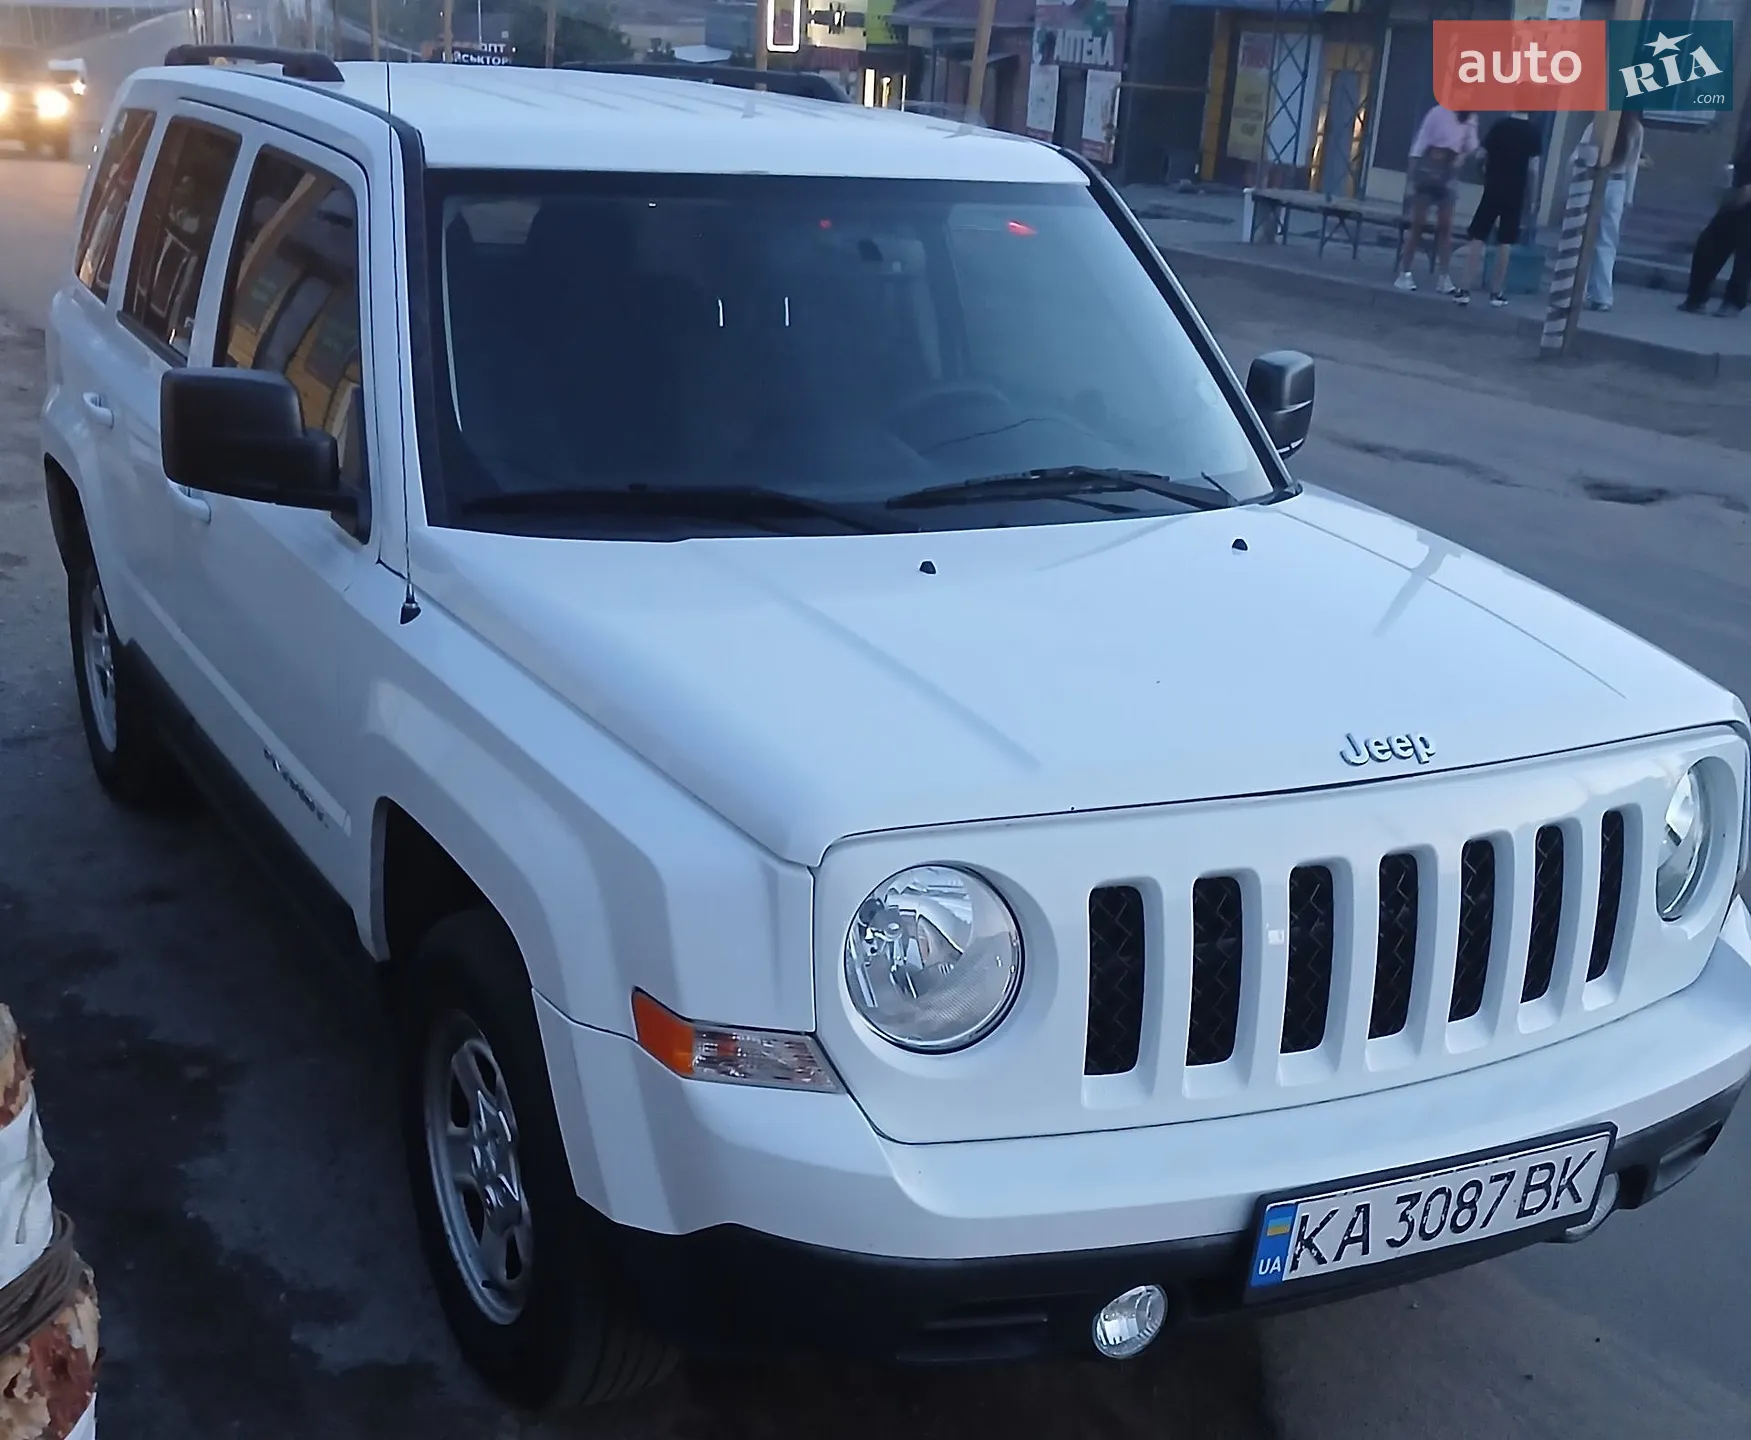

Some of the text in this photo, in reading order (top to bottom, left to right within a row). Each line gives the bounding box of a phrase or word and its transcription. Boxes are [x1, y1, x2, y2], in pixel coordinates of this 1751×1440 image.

[1053, 28, 1115, 67] АПТЕКА
[1340, 732, 1436, 767] Jeep
[1289, 1150, 1596, 1274] KA 3087 BK
[1258, 1255, 1282, 1275] UA
